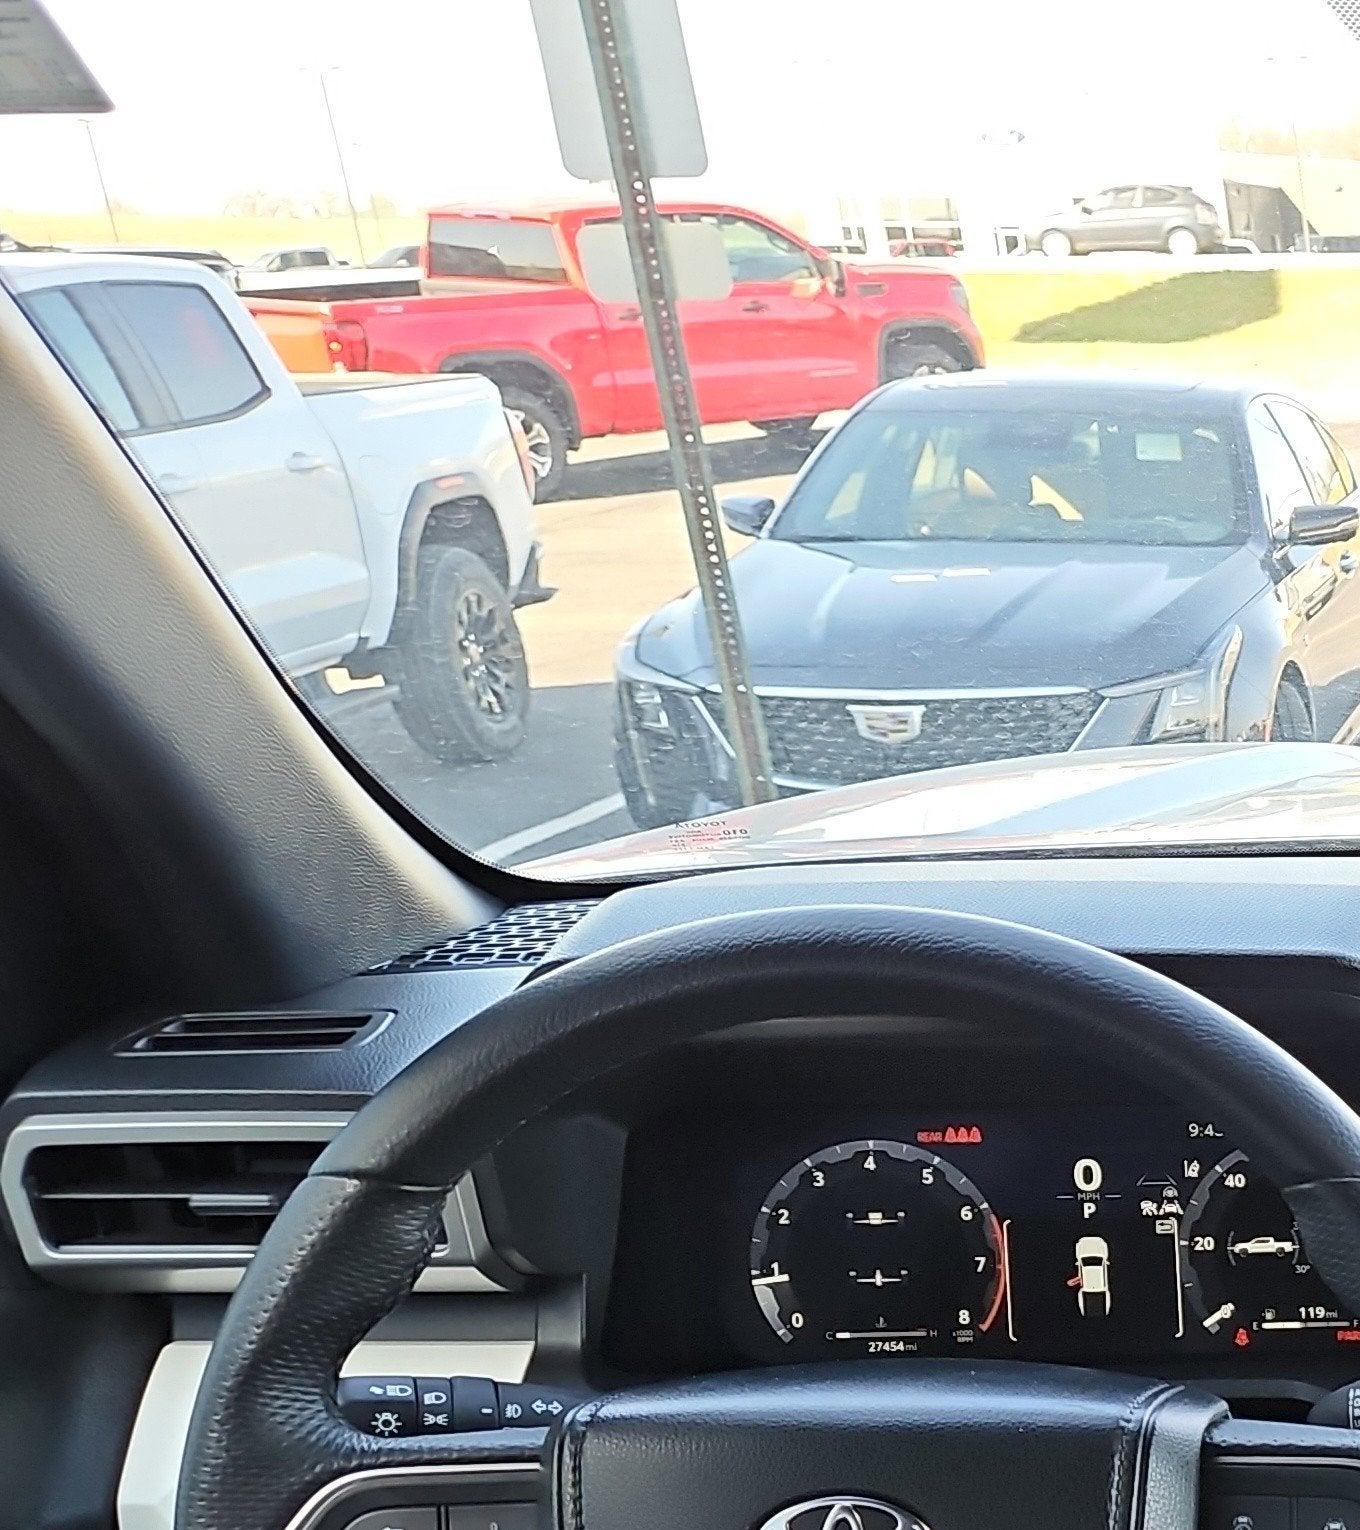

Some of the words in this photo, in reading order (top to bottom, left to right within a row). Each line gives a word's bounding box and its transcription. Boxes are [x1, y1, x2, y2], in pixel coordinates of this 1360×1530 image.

[1188, 1123, 1225, 1138] 9:4
[863, 1156, 876, 1171] 4
[812, 1171, 825, 1187] 3
[921, 1168, 934, 1185] 5
[1073, 1158, 1102, 1192] 0
[1224, 1173, 1247, 1188] 40
[777, 1209, 790, 1225] 2
[960, 1205, 973, 1221] 6
[1083, 1202, 1097, 1219] P
[1193, 1236, 1215, 1251] 20
[974, 1256, 986, 1273] 7
[958, 1309, 970, 1325] 8
[1299, 1306, 1325, 1319] 119
[1325, 1310, 1338, 1319] mi
[791, 1312, 804, 1329] 0
[1252, 1322, 1259, 1331] E
[1353, 1318, 1360, 1328] F
[825, 1331, 834, 1341] C
[929, 1329, 938, 1339] H
[868, 1341, 905, 1353] 27454
[904, 1342, 917, 1351] mi
